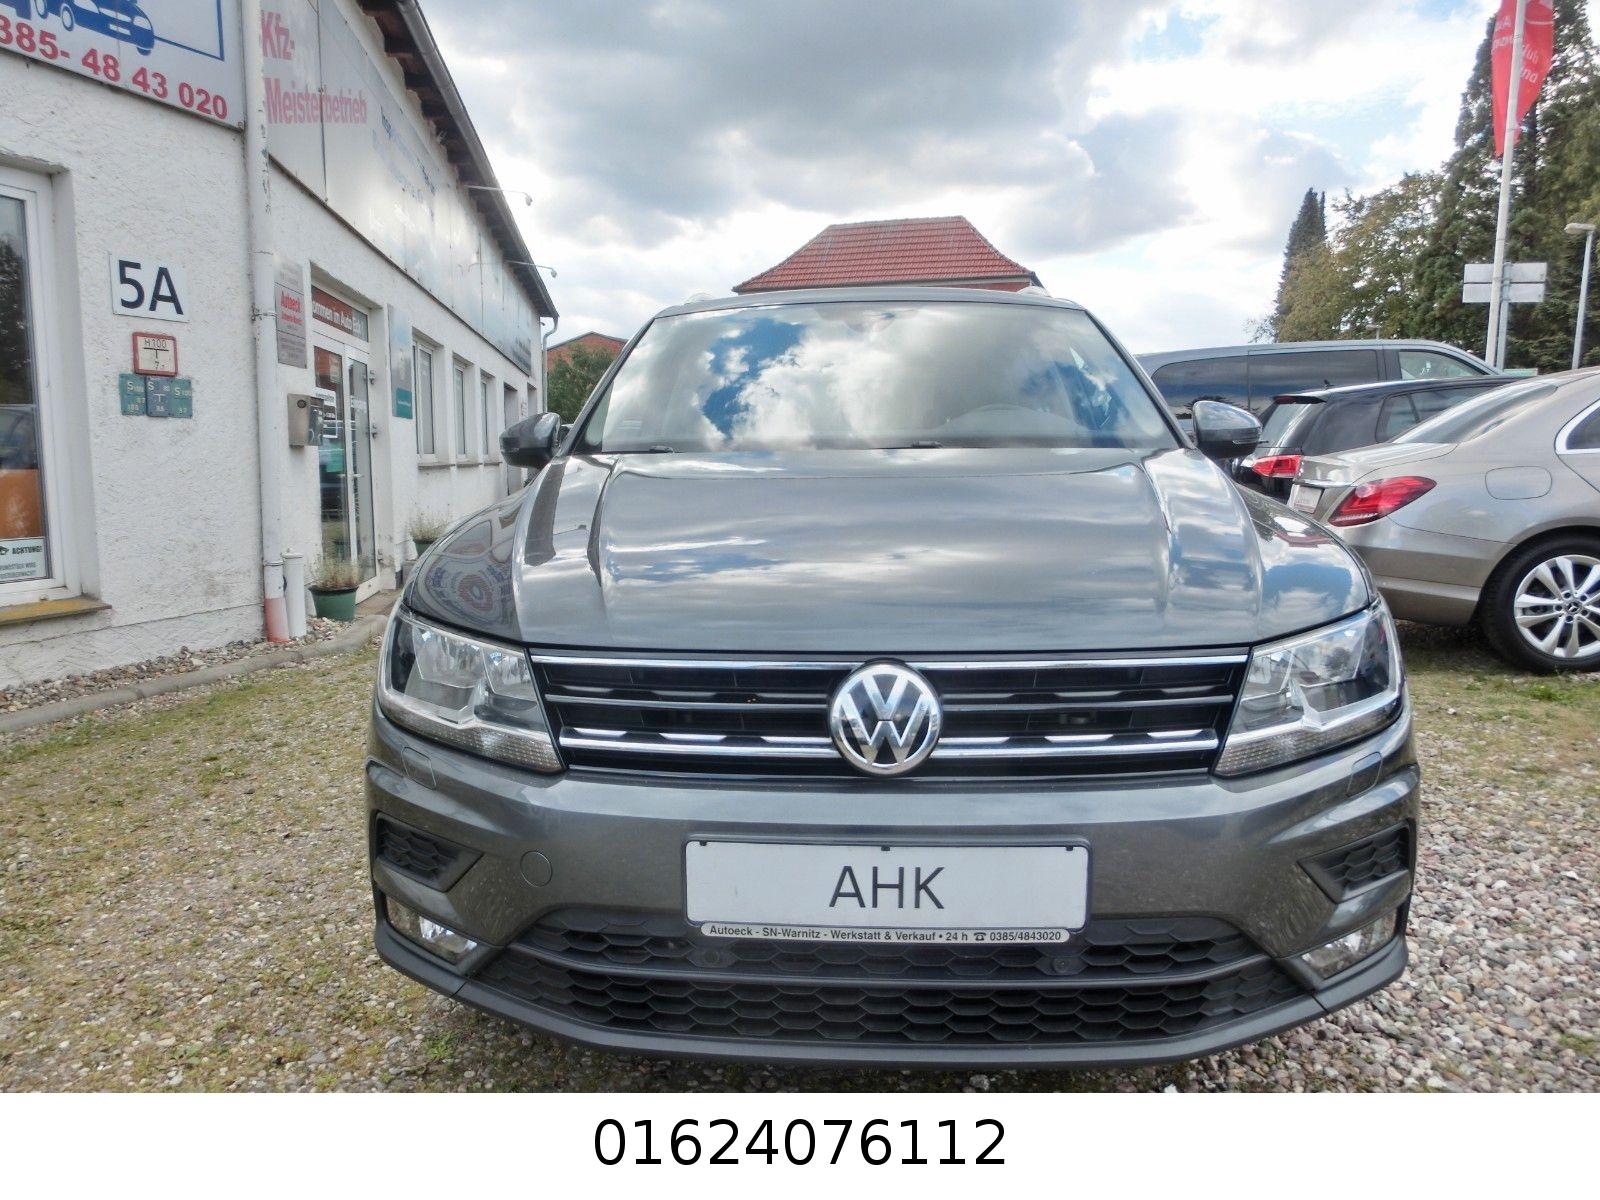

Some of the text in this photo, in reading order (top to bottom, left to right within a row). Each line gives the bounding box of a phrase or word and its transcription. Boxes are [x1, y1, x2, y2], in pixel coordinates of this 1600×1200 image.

[261, 11, 295, 60] Kfz-
[81, 48, 121, 82] 48
[131, 66, 169, 99] 43
[178, 81, 228, 120] 020
[264, 77, 367, 124] Meisterbetrieb
[118, 259, 184, 315] 5A
[828, 865, 946, 909] AHK
[709, 925, 753, 936] Autoeck
[762, 927, 821, 939] SN-Warnitz
[830, 929, 881, 941] Werkstatt
[896, 930, 936, 941] Verkauf
[945, 931, 958, 941] 24
[961, 931, 968, 941] h
[989, 930, 1062, 942] 0385/4843020
